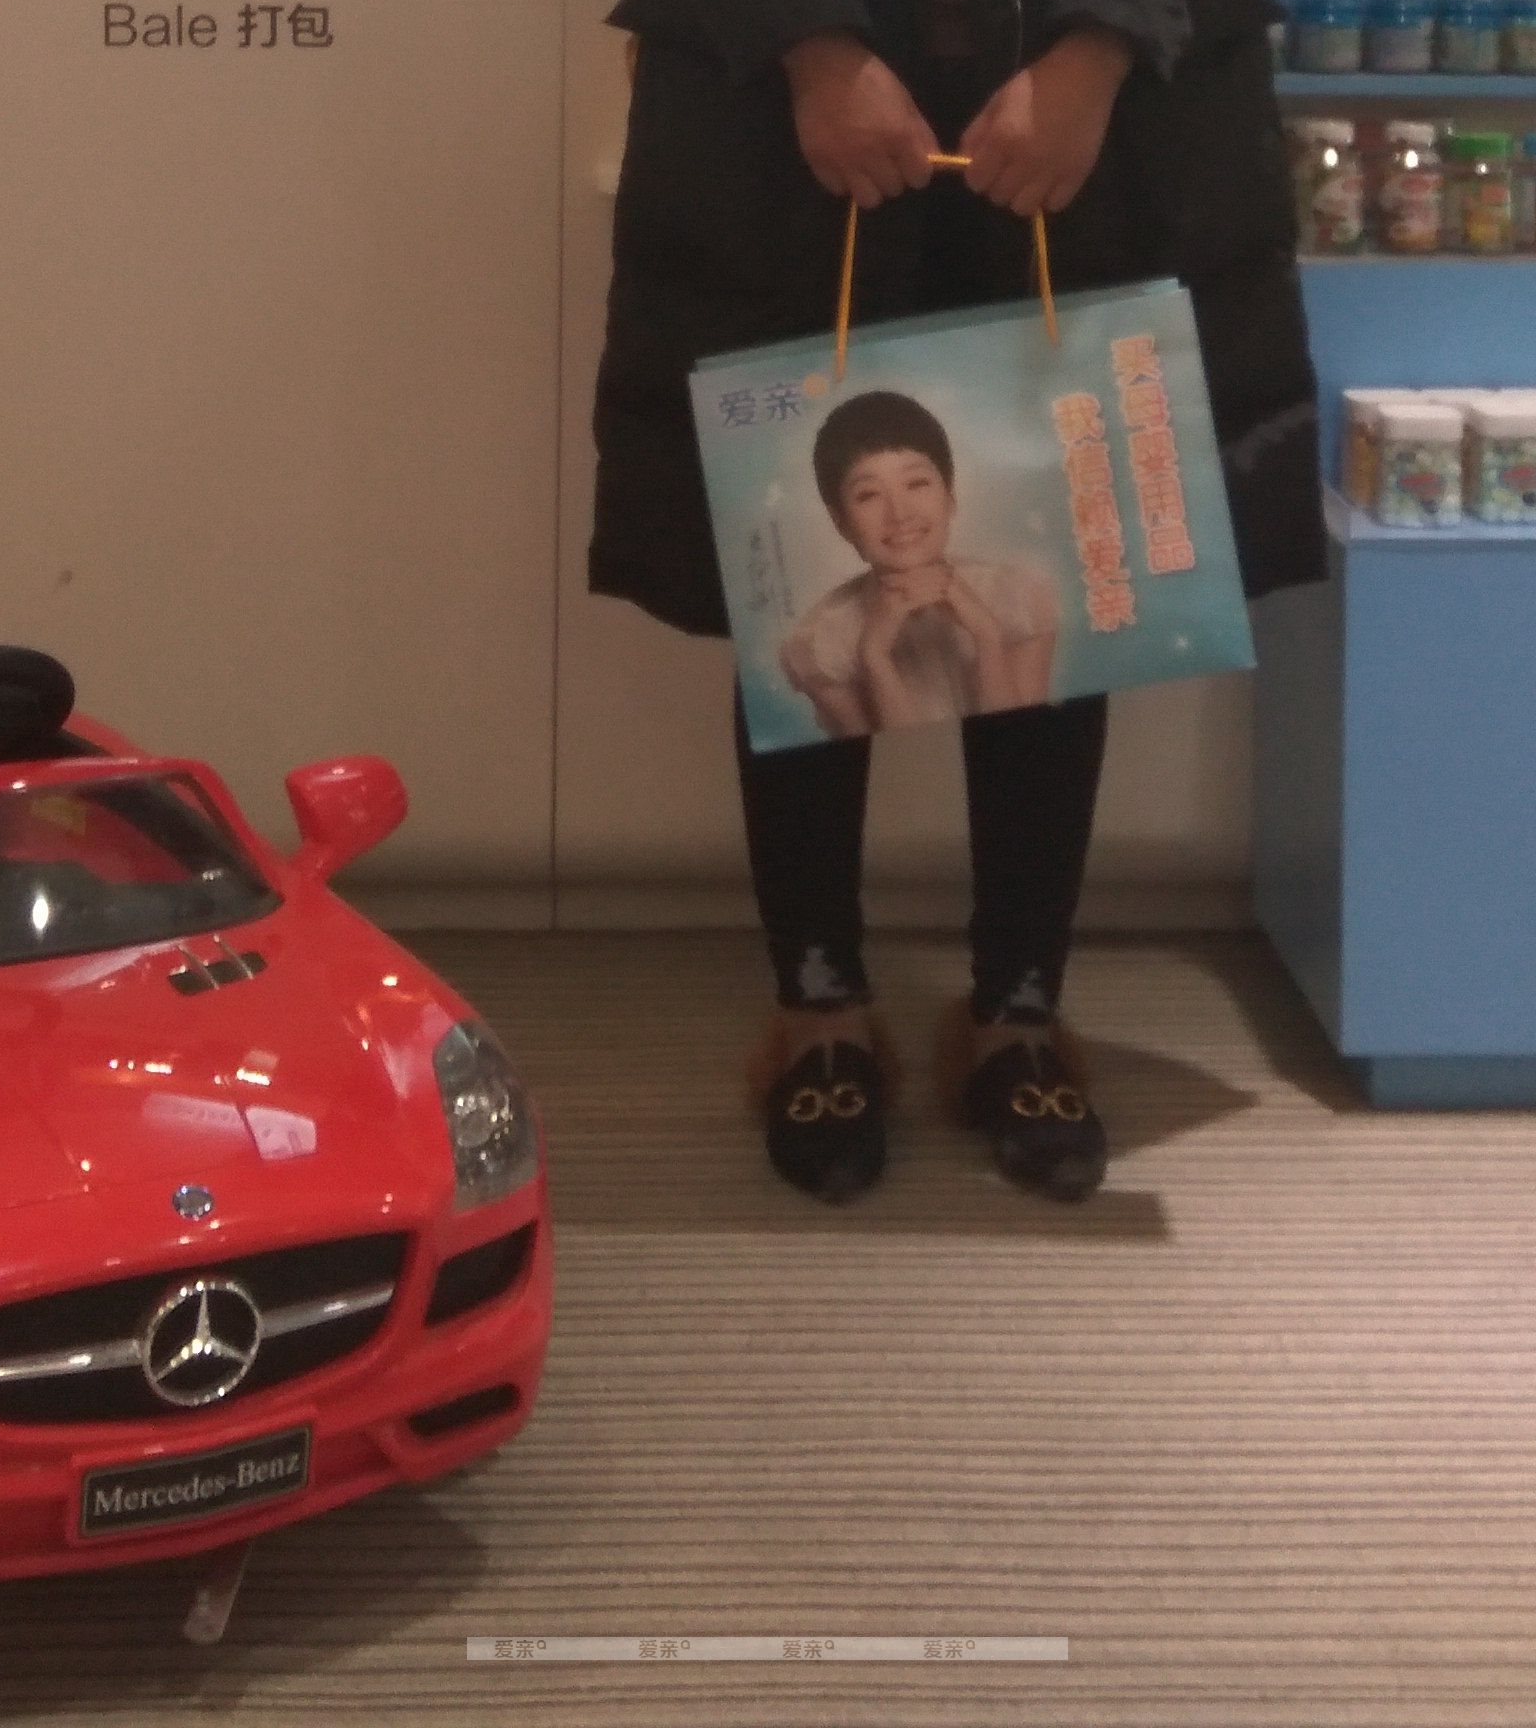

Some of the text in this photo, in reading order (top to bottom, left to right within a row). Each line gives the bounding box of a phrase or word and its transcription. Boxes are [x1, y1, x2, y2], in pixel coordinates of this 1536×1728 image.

[103, 2, 334, 49] Bale 打包
[92, 1452, 302, 1517] Mercedes-Benz
